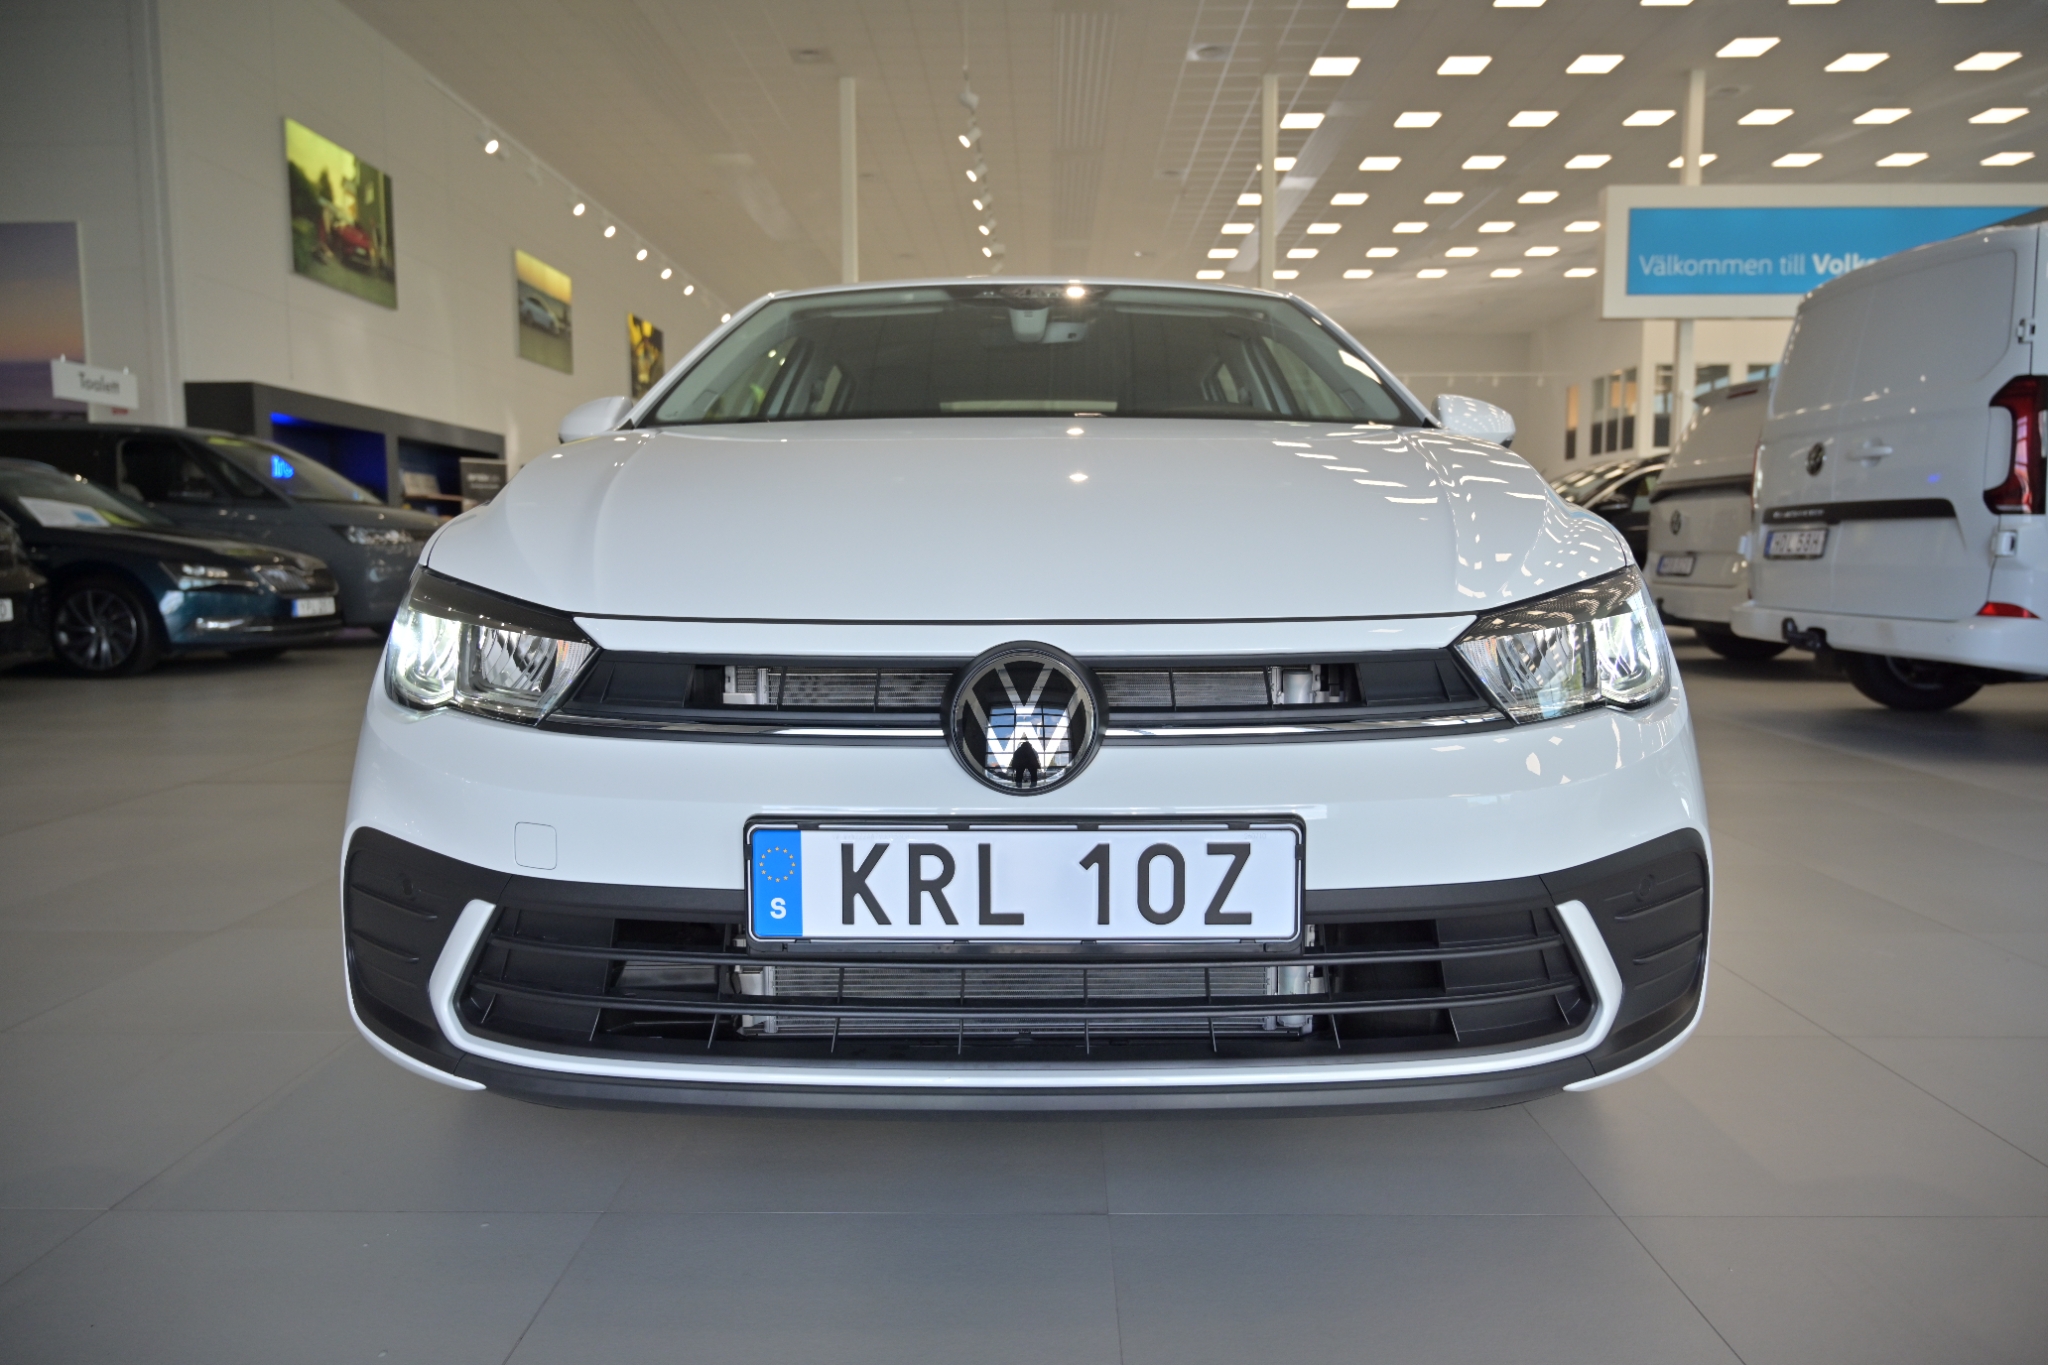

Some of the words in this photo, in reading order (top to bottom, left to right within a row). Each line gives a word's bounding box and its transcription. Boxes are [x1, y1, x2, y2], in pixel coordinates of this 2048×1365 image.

[1639, 252, 1773, 276] Välkommen
[1779, 253, 1806, 276] till
[79, 371, 120, 395] Toalett
[769, 897, 787, 919] S
[841, 843, 1024, 925] KRL
[1079, 843, 1252, 925] 10Z
